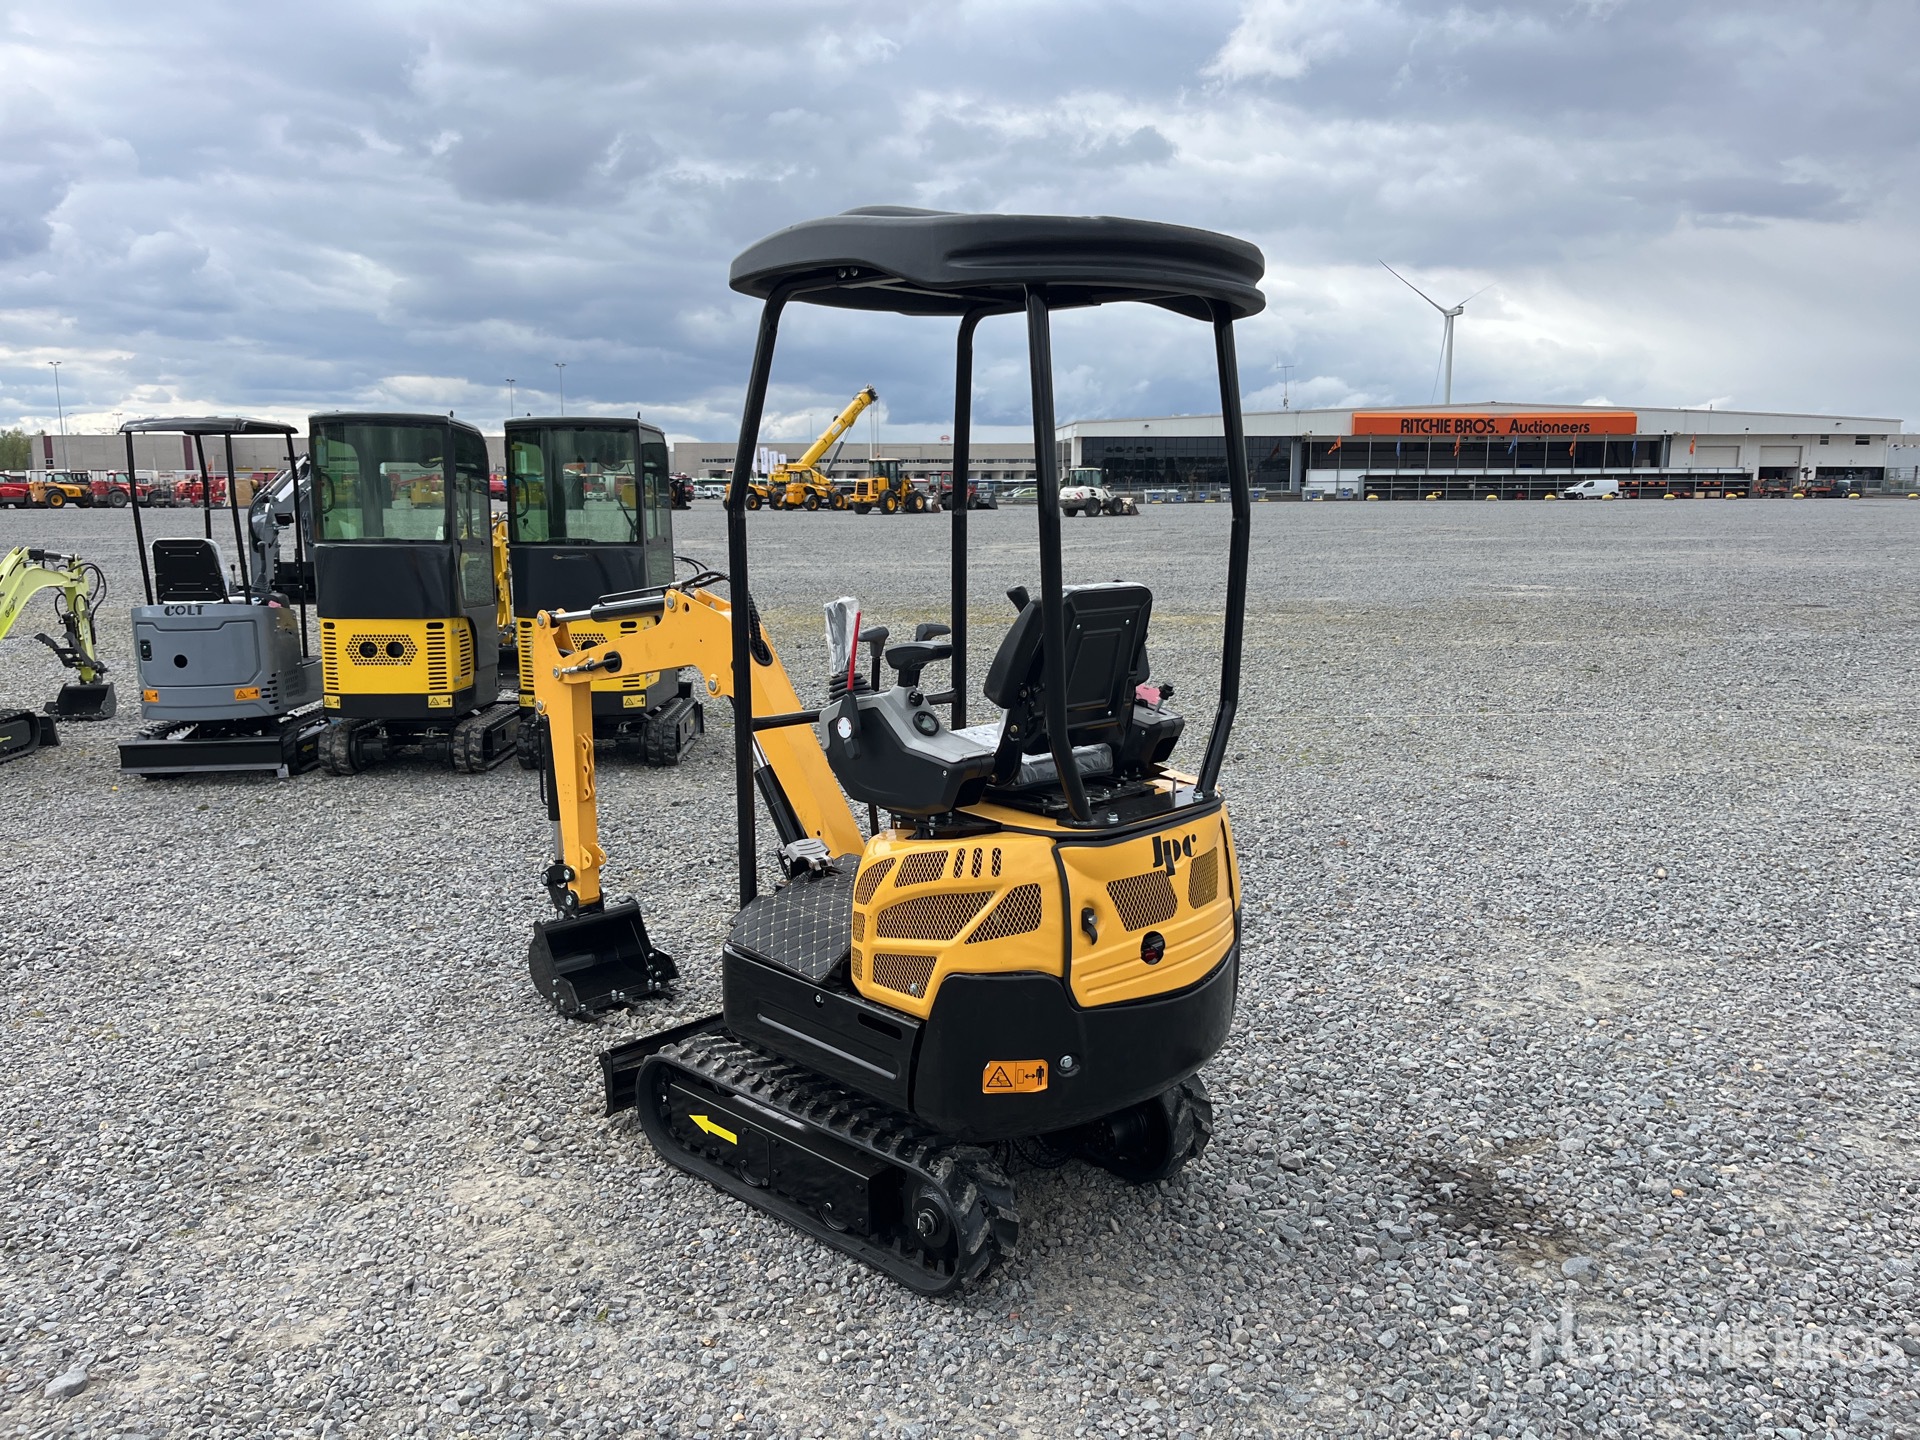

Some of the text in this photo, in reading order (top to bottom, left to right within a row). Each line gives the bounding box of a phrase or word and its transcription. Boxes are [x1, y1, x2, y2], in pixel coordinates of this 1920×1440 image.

[1400, 418, 1590, 434] RITCHIE BROS. Auctioneers
[164, 604, 204, 616] COLT
